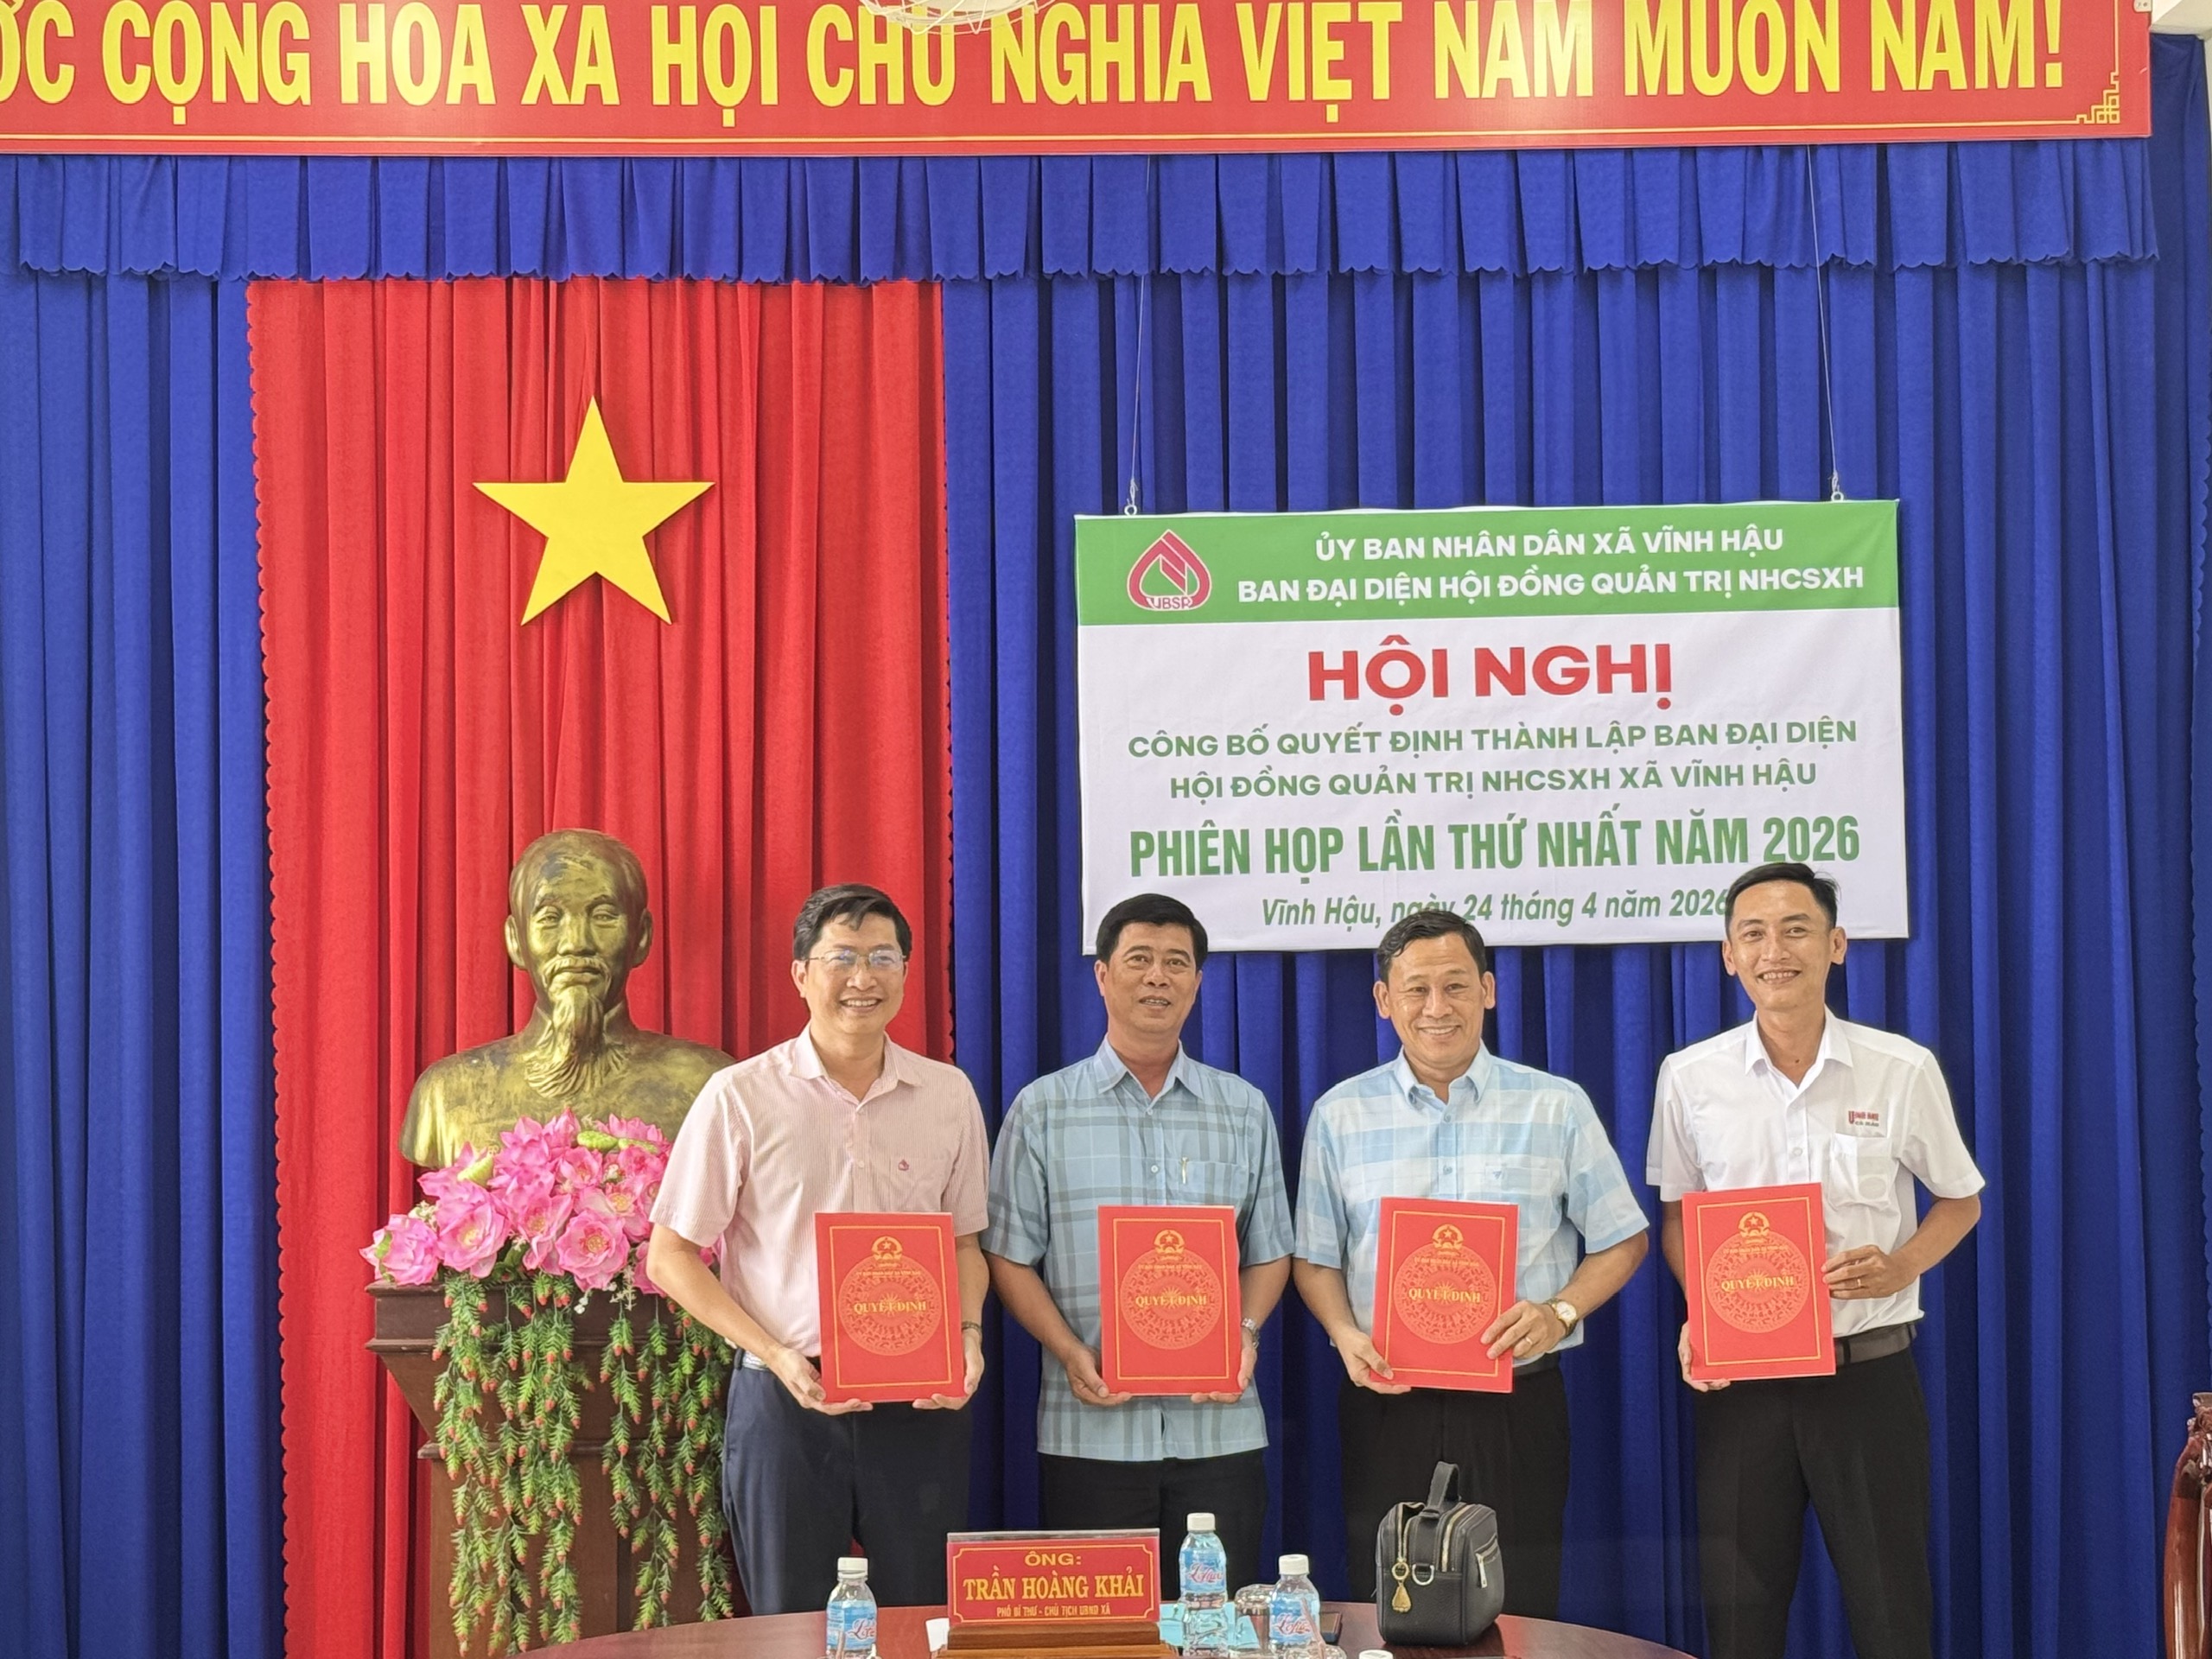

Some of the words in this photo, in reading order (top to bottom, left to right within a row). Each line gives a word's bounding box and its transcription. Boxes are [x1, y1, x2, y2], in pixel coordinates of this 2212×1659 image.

[1434, 0, 1593, 99] NAM
[1315, 531, 1357, 562] ỦY
[1363, 537, 1426, 561] BAN
[1432, 530, 1516, 559] NHÂN
[1522, 528, 1586, 556] DÂN
[1592, 525, 1637, 555] XÃ
[1642, 524, 1714, 554] VĨNH
[1720, 523, 1783, 558] HẬU
[1237, 579, 1300, 603] BAN
[1306, 577, 1357, 607] ĐẠI
[1364, 571, 1433, 607] DIỆN
[1439, 569, 1491, 605] HỘI
[1497, 564, 1586, 597] ĐỒNG
[1591, 563, 1677, 595] QUẢN
[1682, 569, 1732, 599] TRỊ
[1738, 566, 1864, 591] NHCSXH
[1308, 634, 1448, 715] HỘI
[1475, 643, 1672, 709] NGHỊ
[1128, 730, 1218, 758] CÔNG
[1227, 723, 1269, 756] BỐ
[1277, 722, 1382, 755] QUYẾT
[1389, 730, 1463, 759] ĐỊNH
[1471, 721, 1577, 750] THÀNH
[1586, 720, 1646, 753] LẬP
[1655, 724, 1719, 746] BAN
[1726, 722, 1777, 750] ĐẠI
[1787, 715, 1857, 749] DIỆN
[1171, 771, 1223, 804] HỘI
[1230, 765, 1321, 797] ĐỒNG
[1328, 765, 1416, 796] QUẢN
[1425, 772, 1473, 799] TRỊ
[1483, 768, 1611, 791] NHCSXH
[1621, 760, 1662, 788] XÃ
[1672, 760, 1745, 787] VĨNH
[1753, 758, 1815, 791] HẬU
[1130, 819, 1251, 877] PHIÊN
[1265, 826, 1344, 883] HỌP
[1358, 809, 1435, 872] LẦN
[1447, 813, 1527, 870] THỨ
[1537, 804, 1642, 868] NHẤT
[1655, 809, 1750, 865] NĂM
[1763, 815, 1860, 862] 2026
[1262, 897, 1316, 925] Vĩnh
[1324, 894, 1382, 932] Hậu,
[1463, 893, 1493, 921] 24
[1500, 889, 1574, 927] tháng
[1581, 892, 1598, 918] 4
[1605, 888, 1662, 918] năm
[1024, 1551, 1082, 1567] ÔNG:
[963, 1565, 1016, 1600] TRẦN
[1021, 1570, 1090, 1599] HOÀNG
[1094, 1566, 1144, 1598] KHẢI
